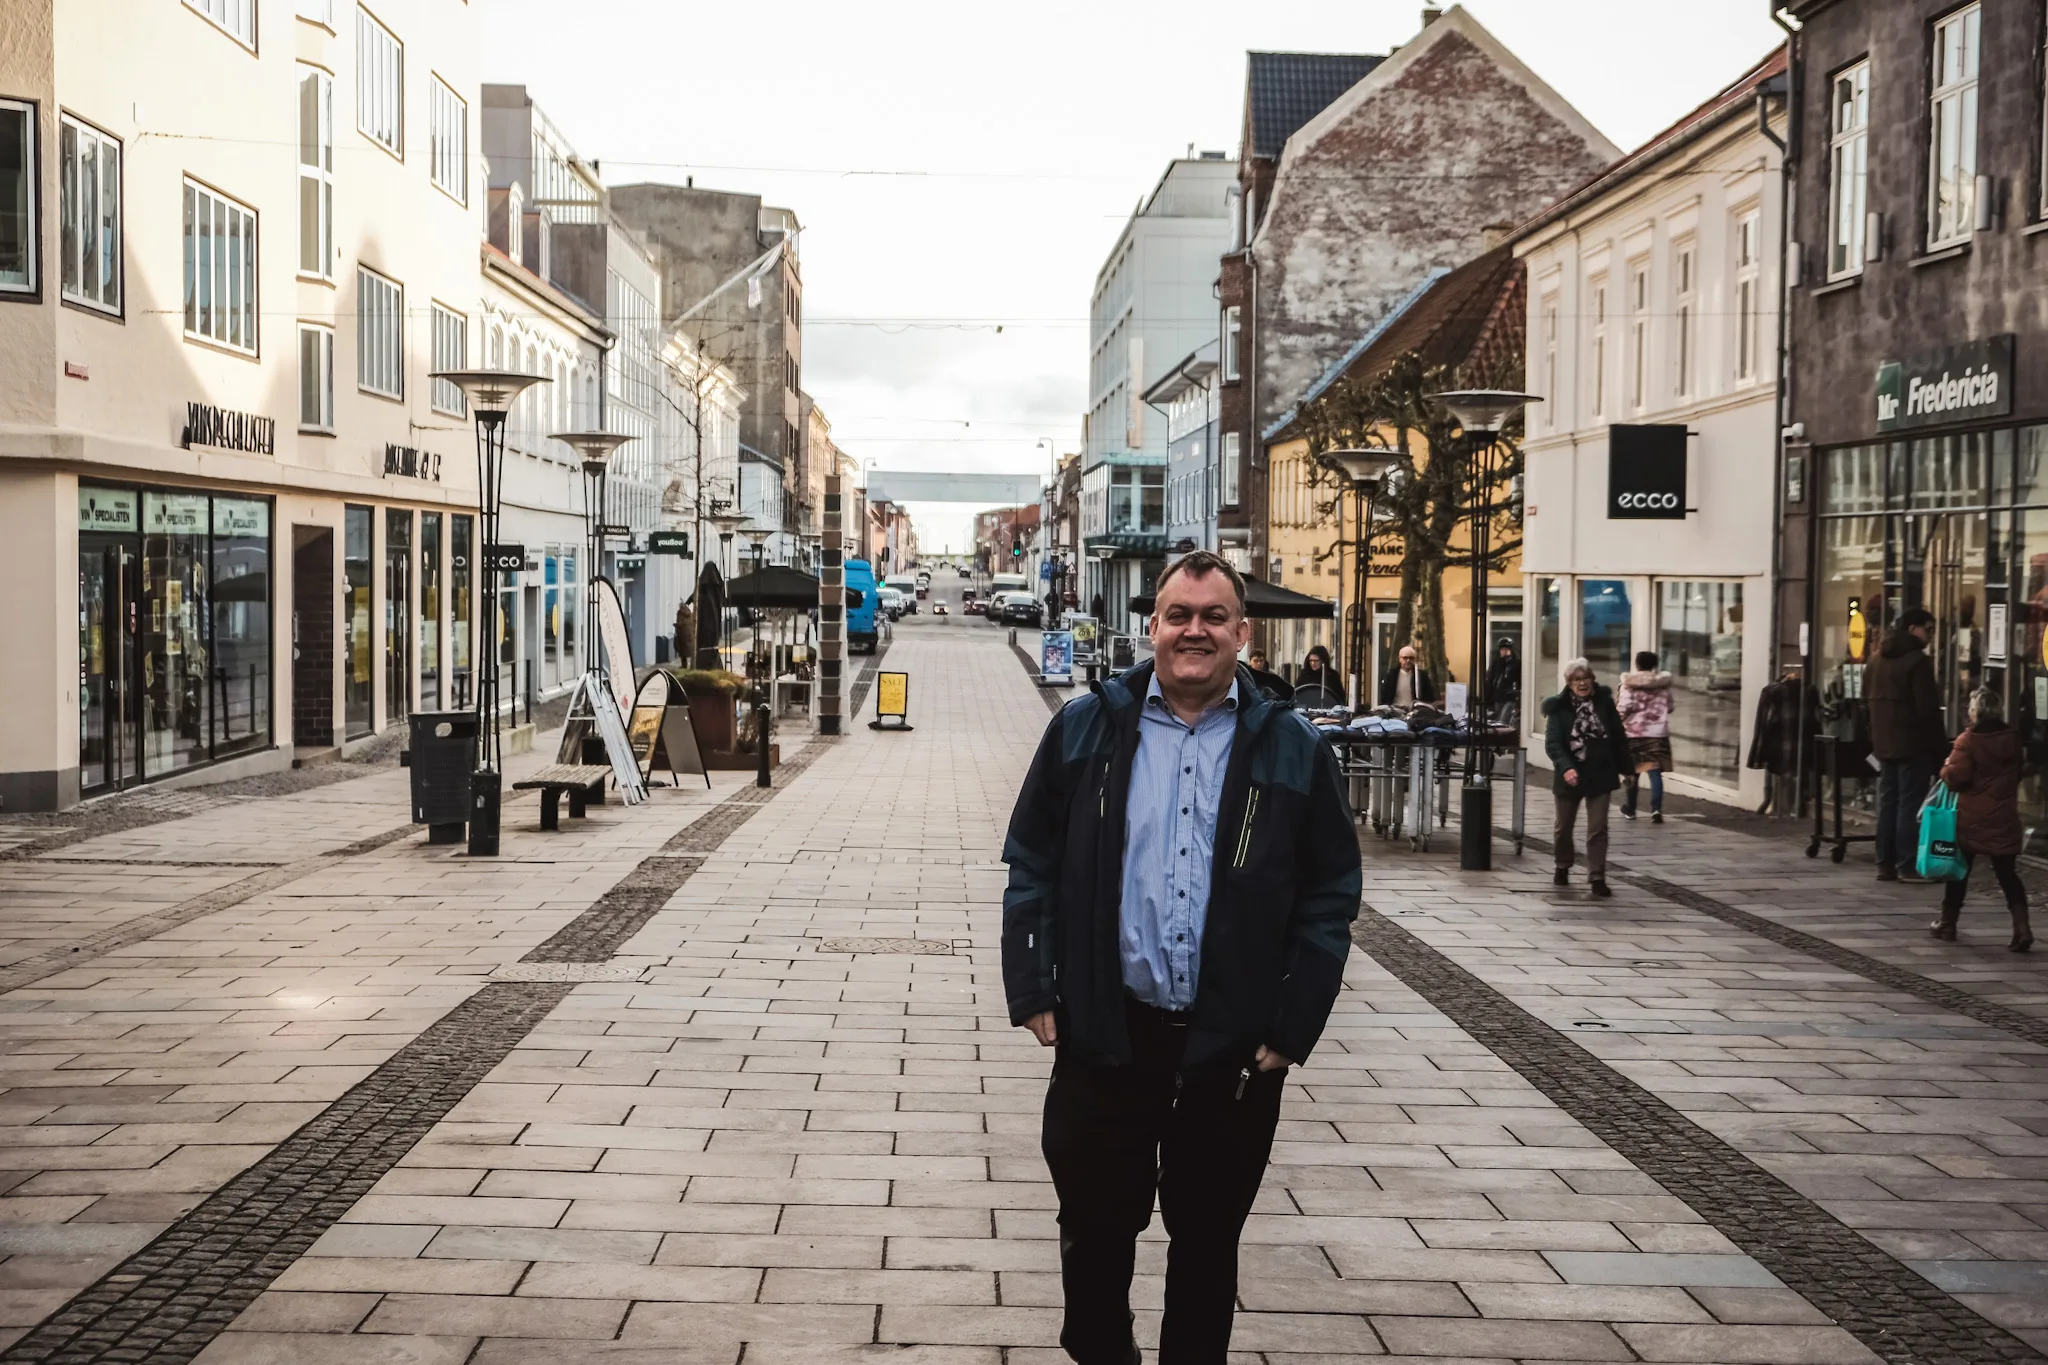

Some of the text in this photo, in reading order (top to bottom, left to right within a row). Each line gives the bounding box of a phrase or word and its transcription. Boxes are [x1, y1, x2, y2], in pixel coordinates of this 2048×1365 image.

[1878, 363, 1998, 420] Mr Fredericia
[1618, 492, 1678, 509] ecco
